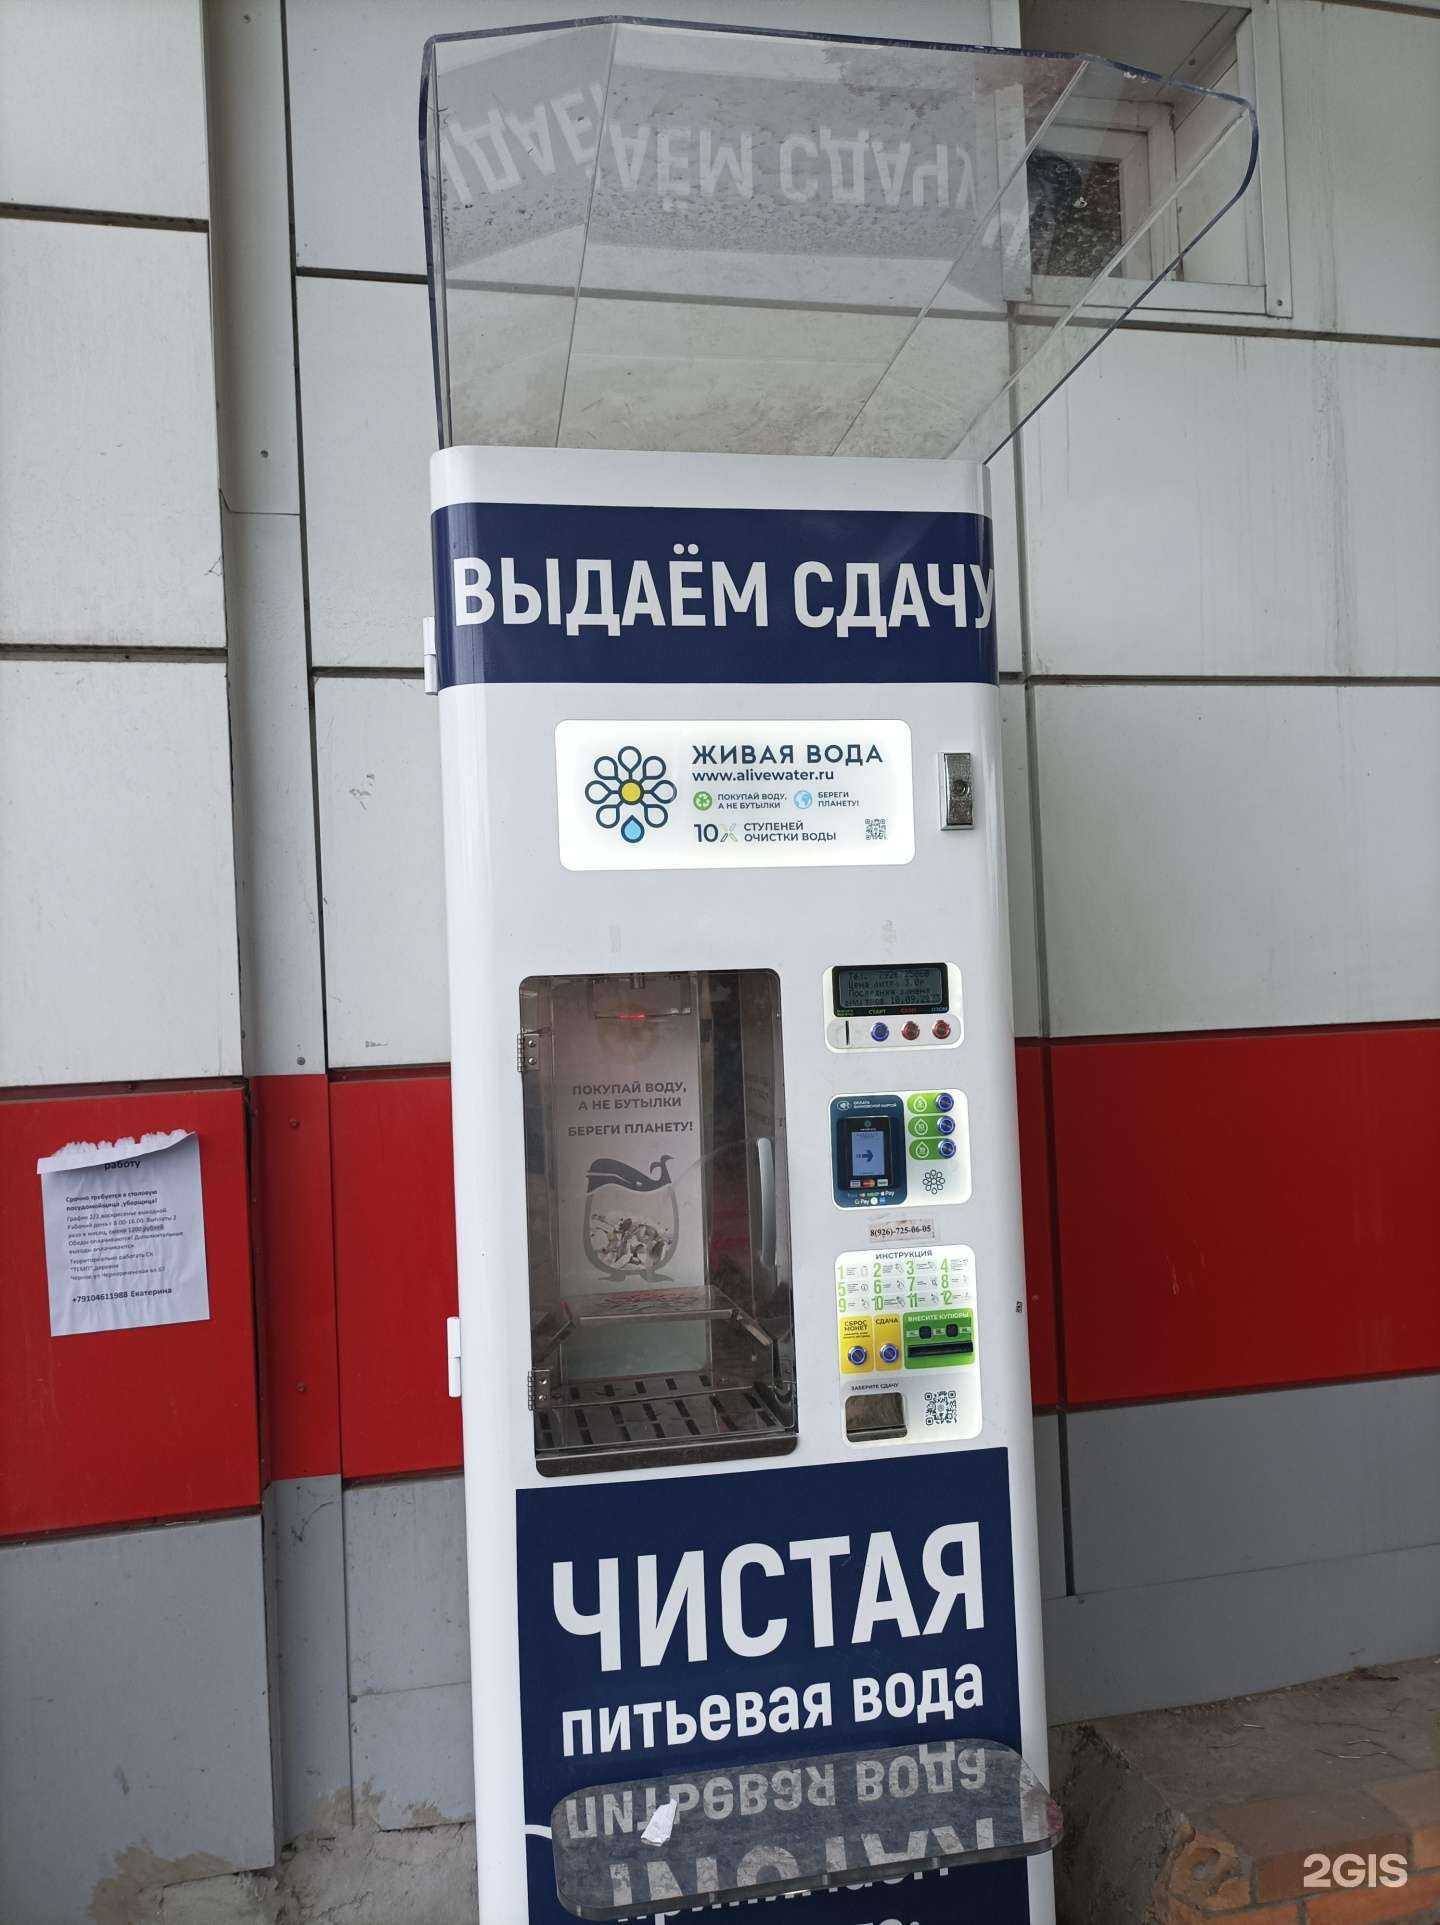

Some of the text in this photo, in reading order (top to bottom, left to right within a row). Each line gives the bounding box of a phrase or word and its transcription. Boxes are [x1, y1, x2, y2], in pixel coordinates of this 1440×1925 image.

[453, 543, 994, 637] ВЫДАЁМ СДАЧУ
[692, 744, 884, 766] ЖИВАЯ ВОДА
[692, 768, 834, 783] www.alivewater.ru
[717, 791, 787, 801] ПОКУПАЙ ВОДУ,
[818, 790, 850, 799] БЕРЕГИ
[718, 801, 781, 810] А НЕ БУТЫЛКИ
[818, 798, 860, 808] ПЛАНЕТУ!
[743, 819, 804, 832] СТУПЕНЕЙ
[743, 831, 837, 843] ОЧИСТКИ ВОДЫ
[573, 1081, 687, 1096] ПОКУПАЙ ВОДУ,
[578, 1097, 681, 1111] А НЕ БУТЫЛКИ
[568, 1121, 693, 1136] БЕРЕГИ ПЛАНЕТУ!
[104, 1159, 141, 1171] работу
[875, 1249, 933, 1260] ИНСТРУКЦИЯ
[873, 1262, 882, 1278] 2
[905, 1260, 914, 1276] 3
[940, 1258, 949, 1273] 4
[838, 1281, 846, 1297] 5
[873, 1279, 882, 1294] 6
[906, 1276, 915, 1292] 7
[941, 1274, 949, 1289] 8
[130, 1287, 173, 1298] Екатерина
[940, 1290, 952, 1305] 12
[838, 1297, 847, 1312] 9
[872, 1295, 884, 1311] 10
[907, 1293, 918, 1308] 11
[875, 1317, 899, 1325] СДАЧА
[907, 1312, 969, 1322] ВНЕСИТЕ КУПЮРЫ
[552, 1521, 985, 1673] ЧИСТАЯ
[562, 1662, 984, 1757] питьевая вода
